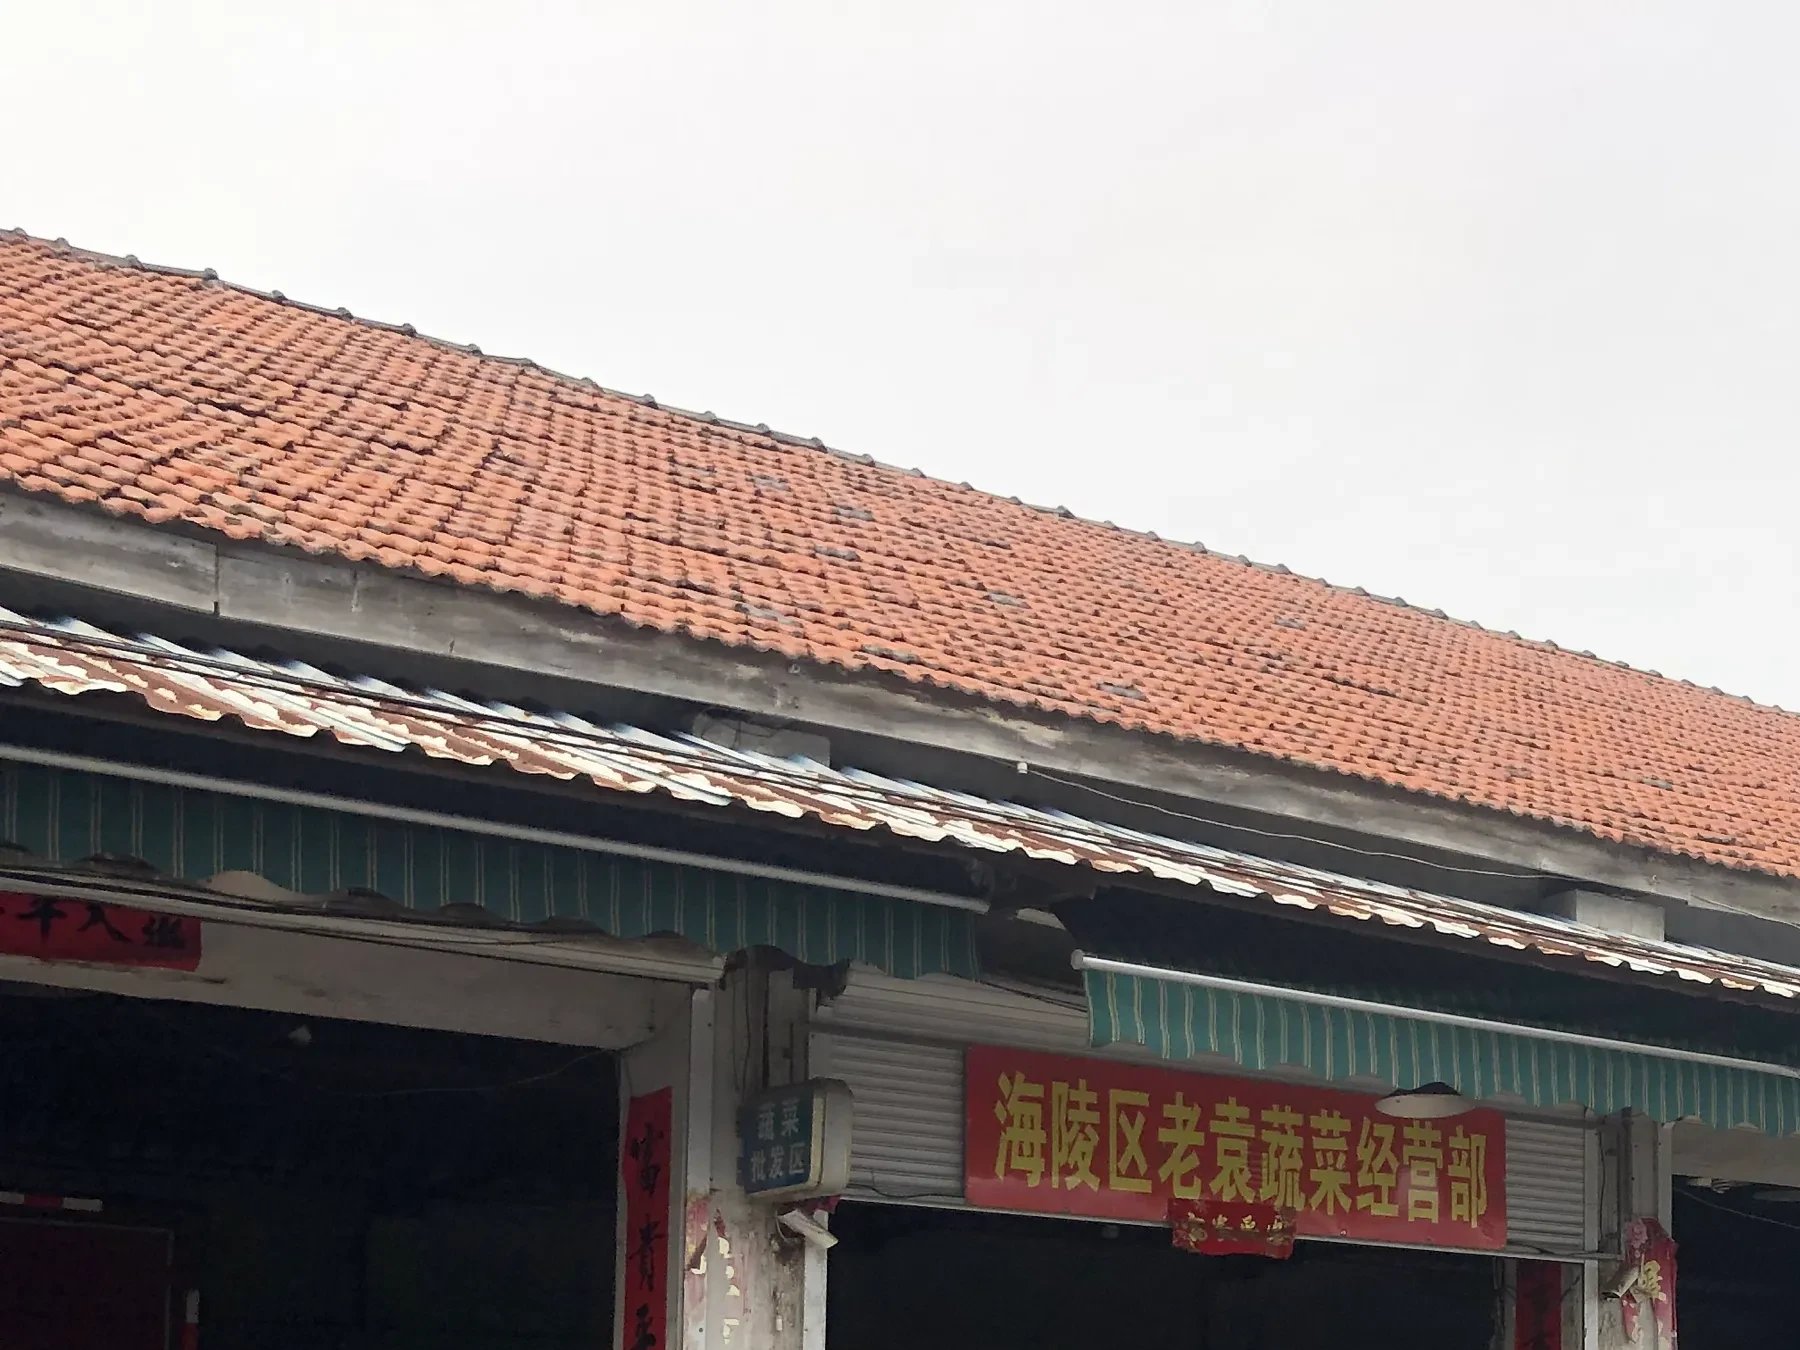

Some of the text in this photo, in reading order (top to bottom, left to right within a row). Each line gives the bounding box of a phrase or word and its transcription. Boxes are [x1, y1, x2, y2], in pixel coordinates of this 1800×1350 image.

[756, 1097, 801, 1141] 蔬菜
[750, 1141, 806, 1184] 批发区
[993, 1071, 1489, 1230] 海陵区老袁蔬菜经营部
